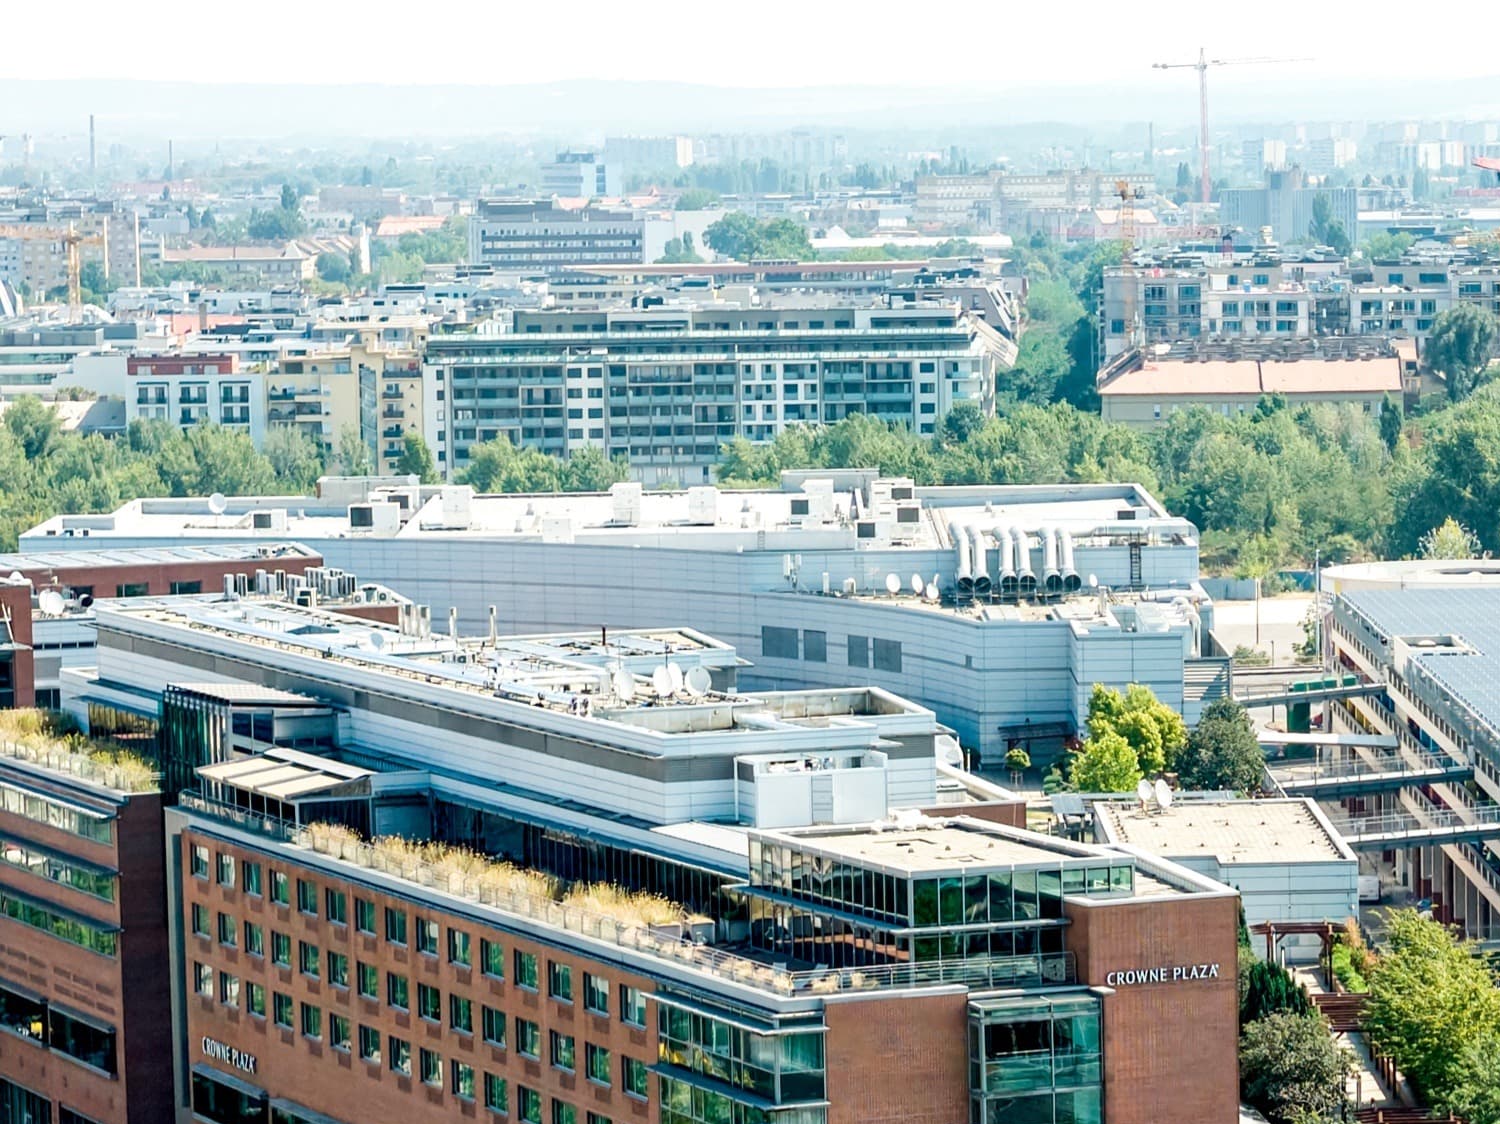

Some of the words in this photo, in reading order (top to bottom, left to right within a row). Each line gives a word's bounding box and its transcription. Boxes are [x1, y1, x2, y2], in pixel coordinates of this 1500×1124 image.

[1106, 967, 1168, 986] CROWNE
[1173, 964, 1219, 982] PLAZA
[202, 1036, 230, 1065] CROWNE
[232, 1048, 255, 1075] PLAZA
